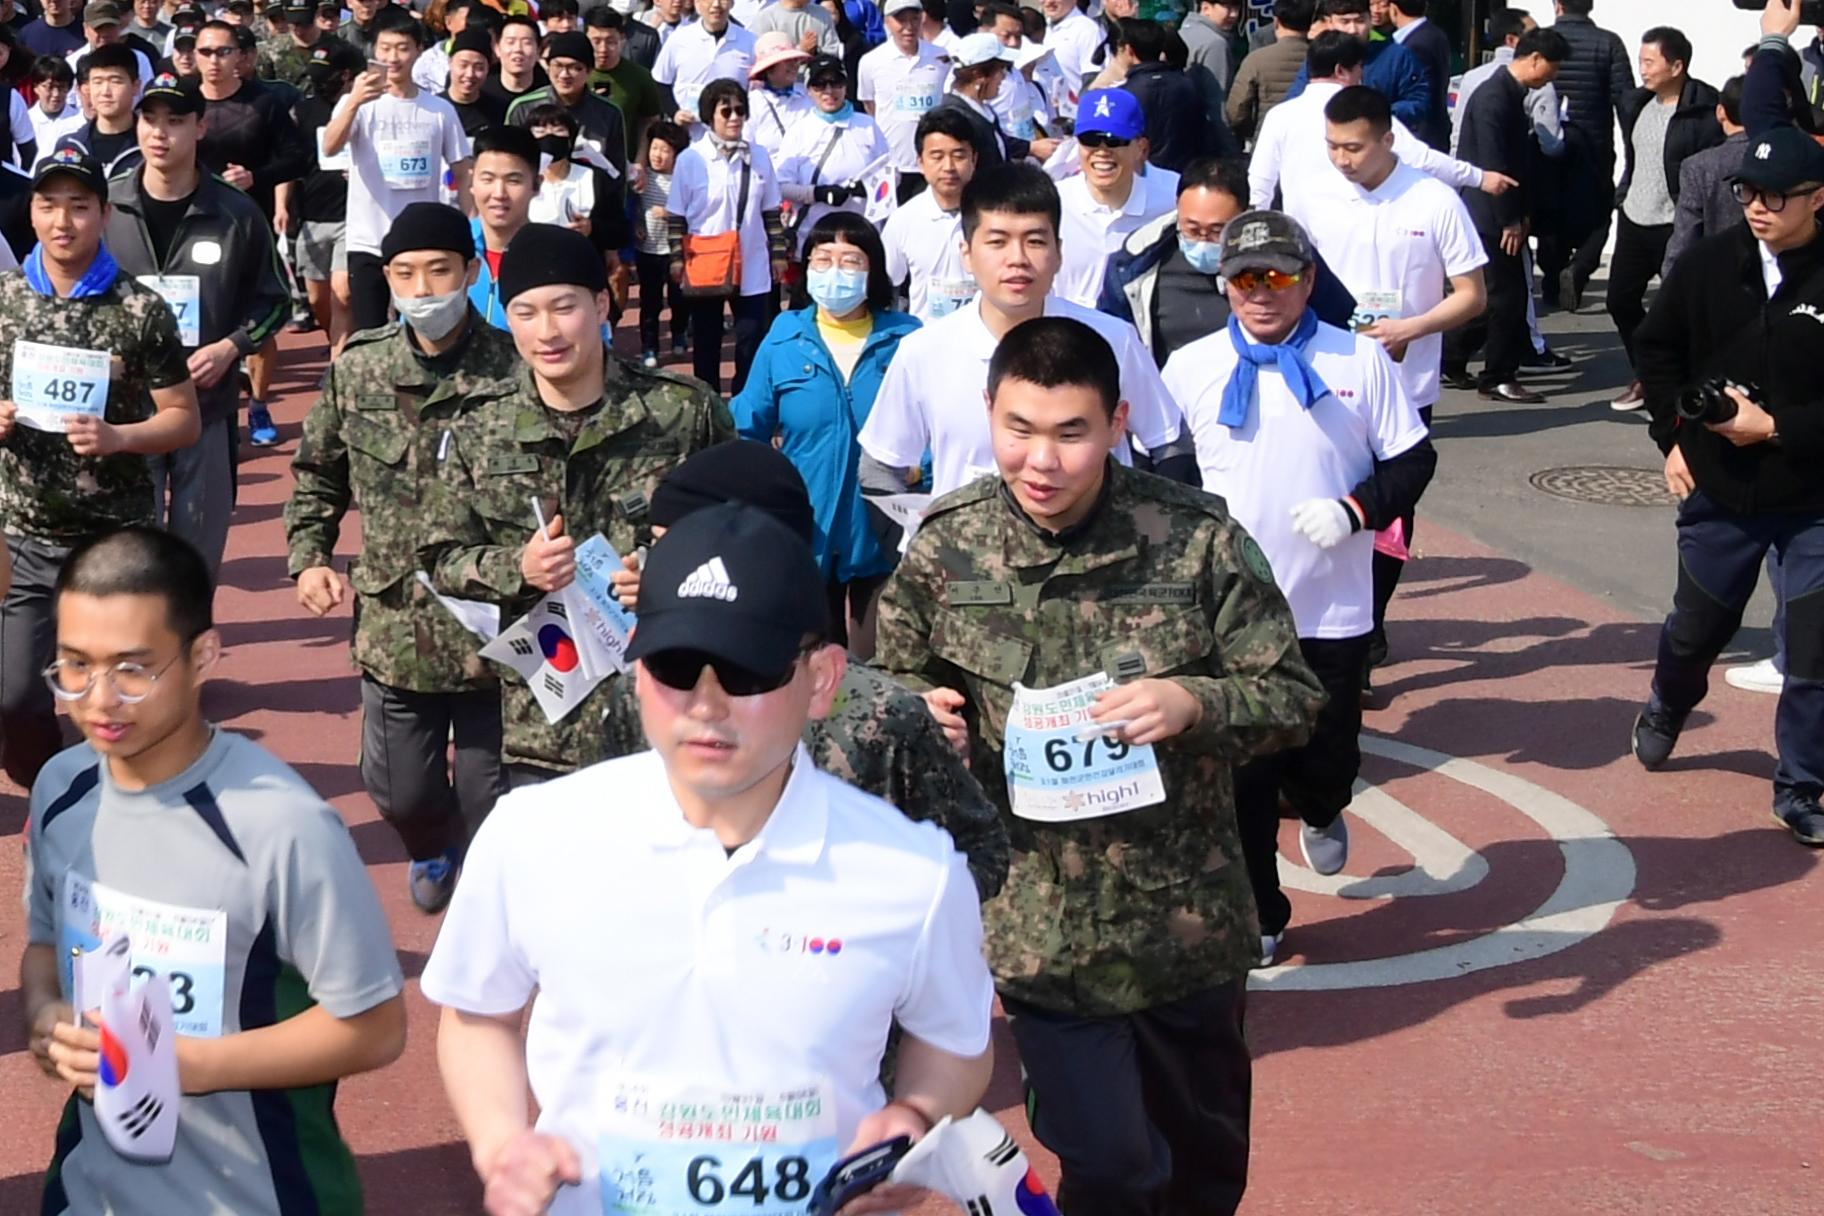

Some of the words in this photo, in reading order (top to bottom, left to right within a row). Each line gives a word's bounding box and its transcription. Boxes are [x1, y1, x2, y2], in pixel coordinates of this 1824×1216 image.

[910, 96, 933, 107] 310
[401, 158, 427, 171] 673
[44, 378, 96, 403] 487
[678, 581, 737, 602] adidas
[1044, 734, 1129, 772] 679
[661, 1096, 822, 1124] 강원도민체육대회
[742, 1124, 780, 1143] 기원
[686, 1154, 811, 1208] 648
